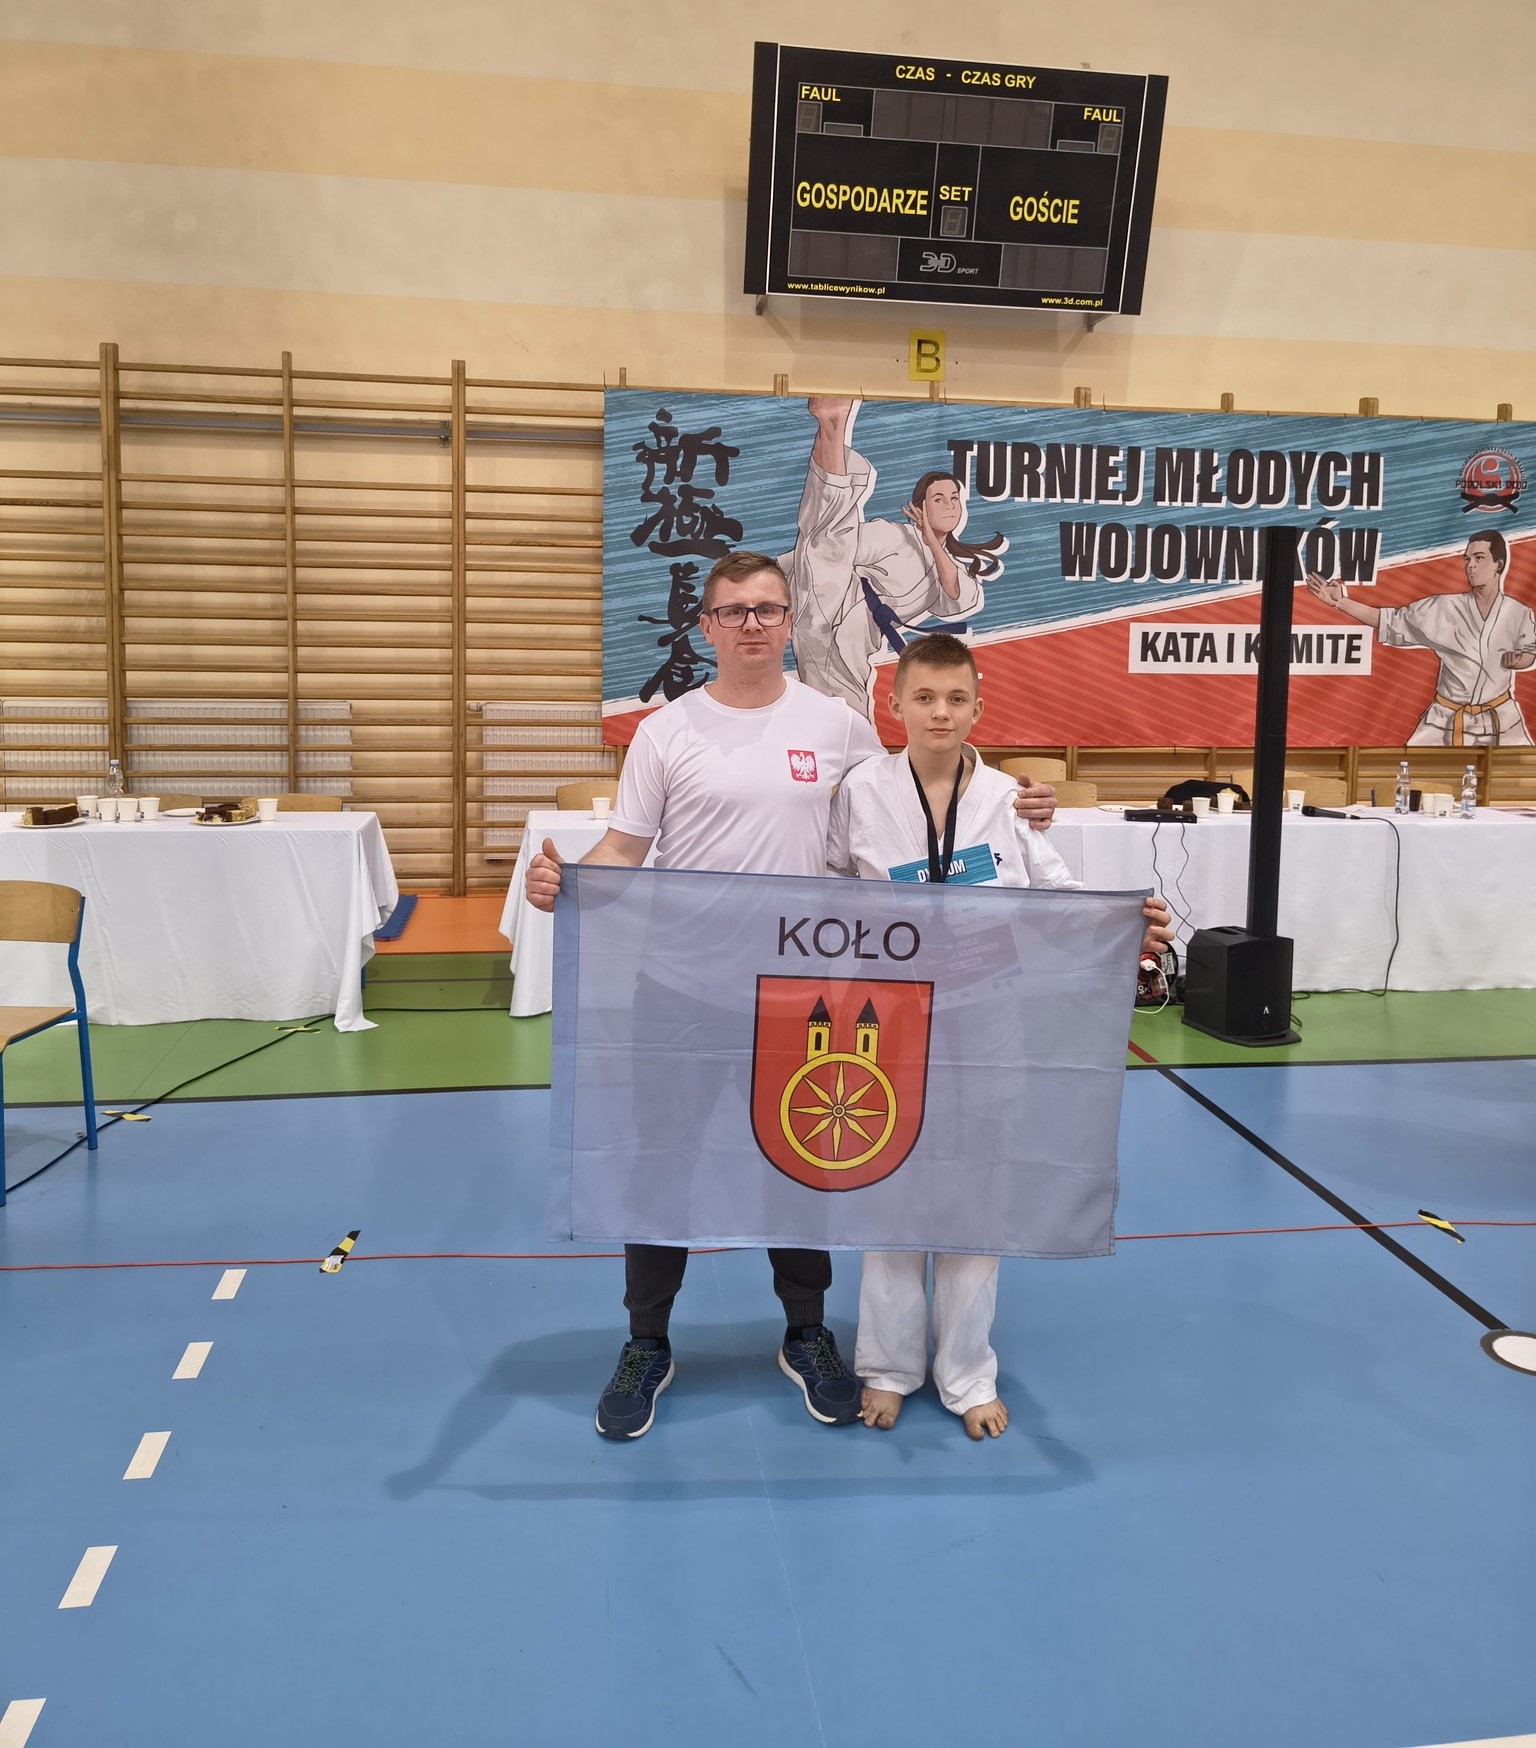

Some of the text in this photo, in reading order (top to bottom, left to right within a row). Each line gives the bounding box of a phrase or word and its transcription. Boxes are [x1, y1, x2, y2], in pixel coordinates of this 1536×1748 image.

[895, 65, 936, 81] CZAS
[961, 70, 1001, 86] CZAS
[1004, 74, 1037, 89] GRY
[801, 85, 841, 102] FAUL
[1083, 107, 1121, 123] FAUL
[796, 181, 929, 216] GOSPODARZE
[938, 185, 973, 202] SET
[1009, 191, 1080, 225] GOŚCIE
[957, 267, 979, 275] SPORT
[787, 282, 886, 295] www.tablicewynikow.pl
[1040, 296, 1104, 307] www.3d.com.pl
[915, 338, 941, 374] B
[946, 439, 1382, 509] TURNIEJ MŁODYCH
[1139, 631, 1363, 664] KATA I KMITE
[777, 915, 921, 962] KOŁO
